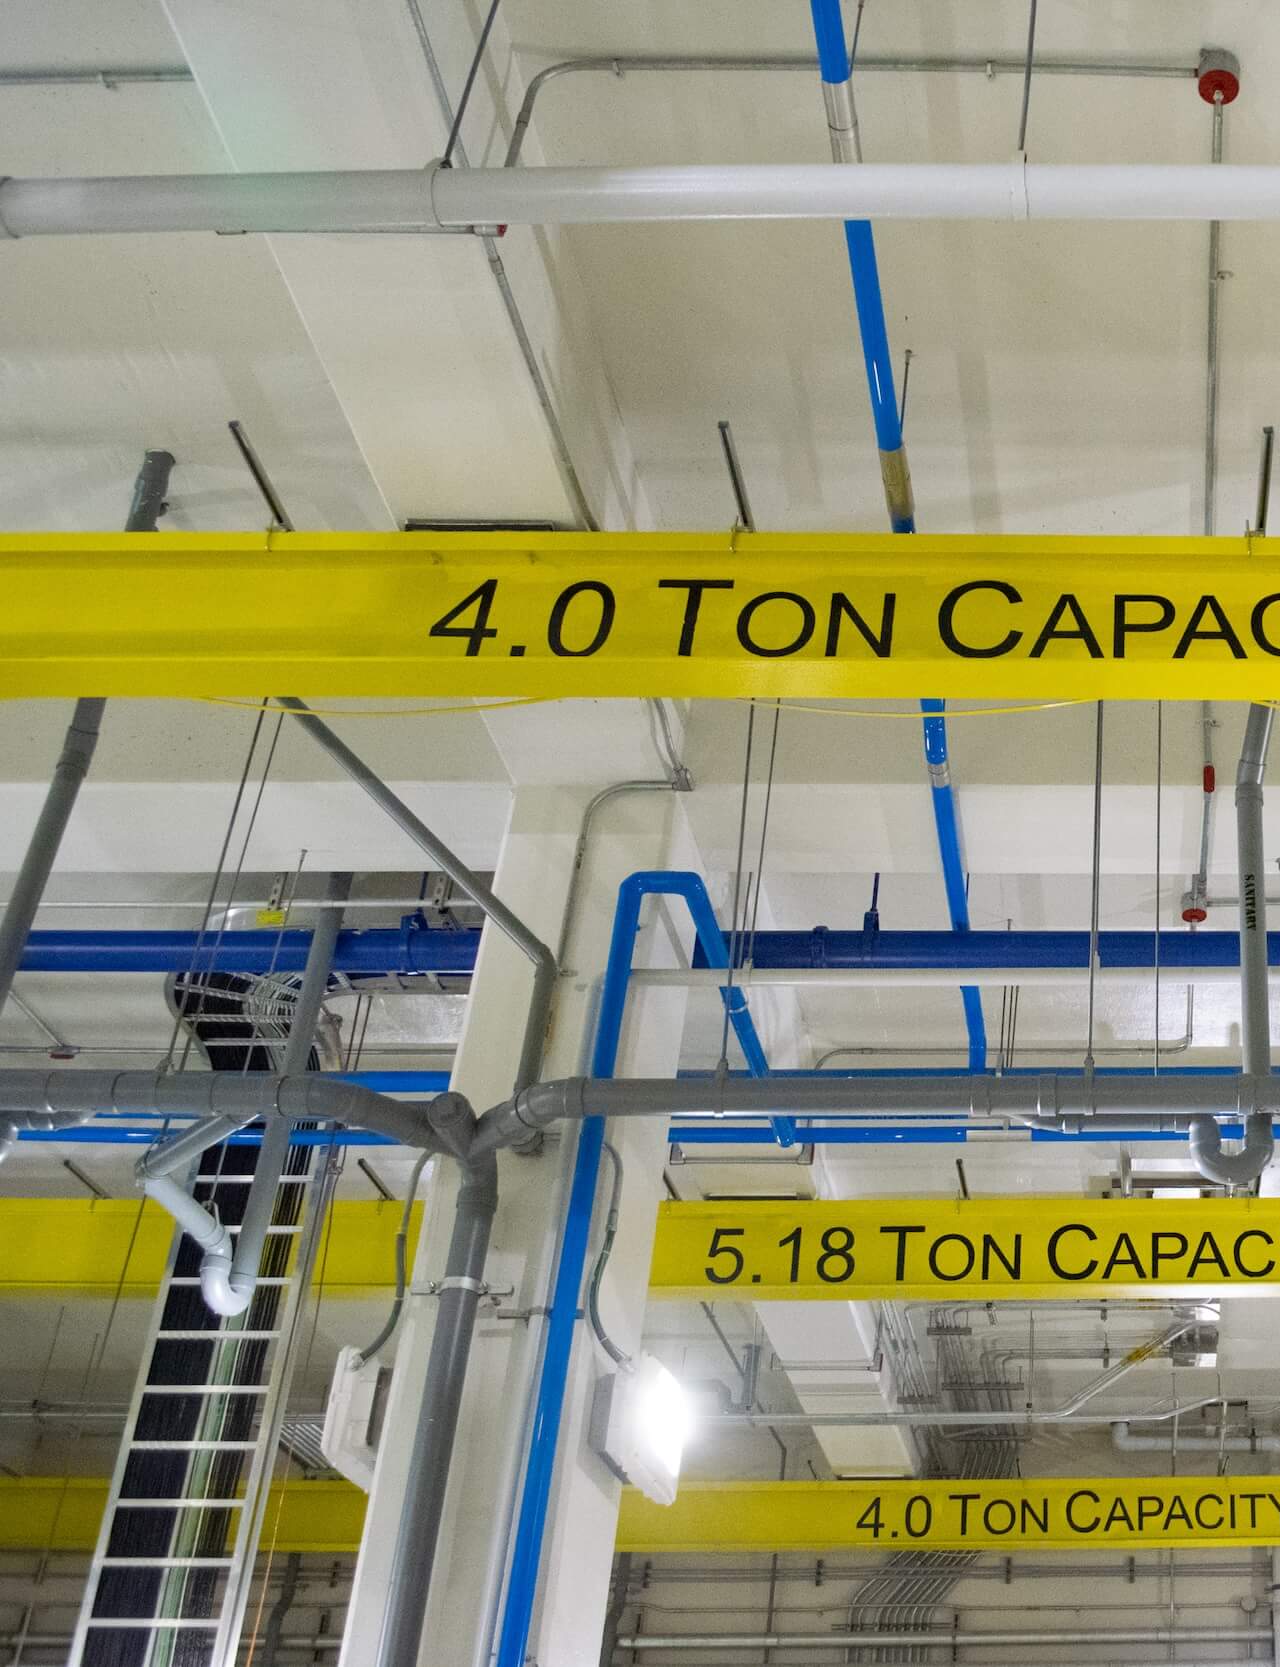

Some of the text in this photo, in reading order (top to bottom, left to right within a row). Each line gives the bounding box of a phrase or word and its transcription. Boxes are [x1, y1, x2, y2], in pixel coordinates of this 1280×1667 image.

[428, 578, 616, 657] 4.0
[657, 579, 897, 658] TON
[1244, 873, 1257, 932] SANITARY
[705, 1226, 855, 1284] 5.18
[879, 1225, 1022, 1282] TON
[856, 1495, 932, 1538] 4.0
[948, 1494, 1048, 1536] TON
